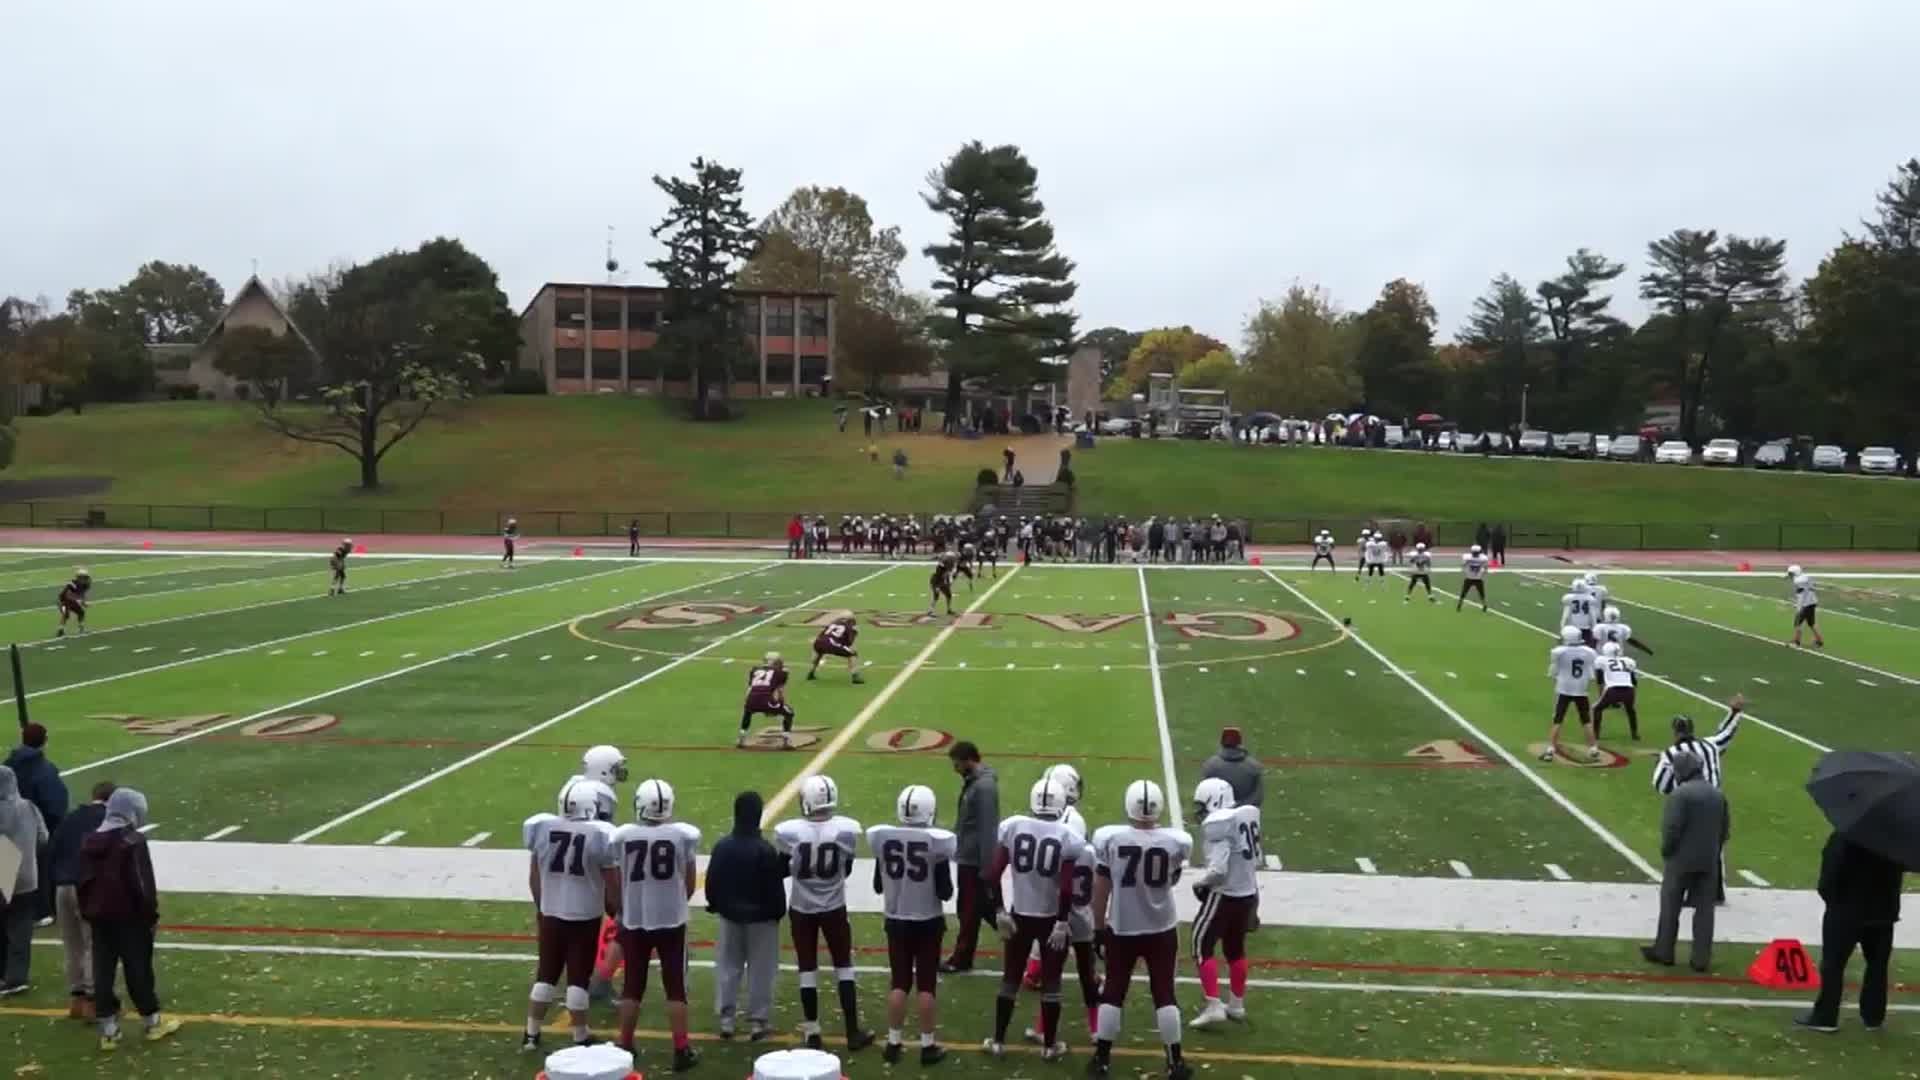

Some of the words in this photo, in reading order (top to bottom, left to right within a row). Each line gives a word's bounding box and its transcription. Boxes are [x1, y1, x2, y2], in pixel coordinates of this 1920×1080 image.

[752, 669, 775, 686] 21
[1571, 659, 1584, 678] 6
[549, 831, 585, 876] 71
[625, 839, 675, 881] 78
[796, 841, 840, 879] 10
[881, 839, 928, 882] 65
[1013, 832, 1062, 878] 80
[1117, 845, 1168, 889] 70
[1776, 947, 1808, 983] 40
